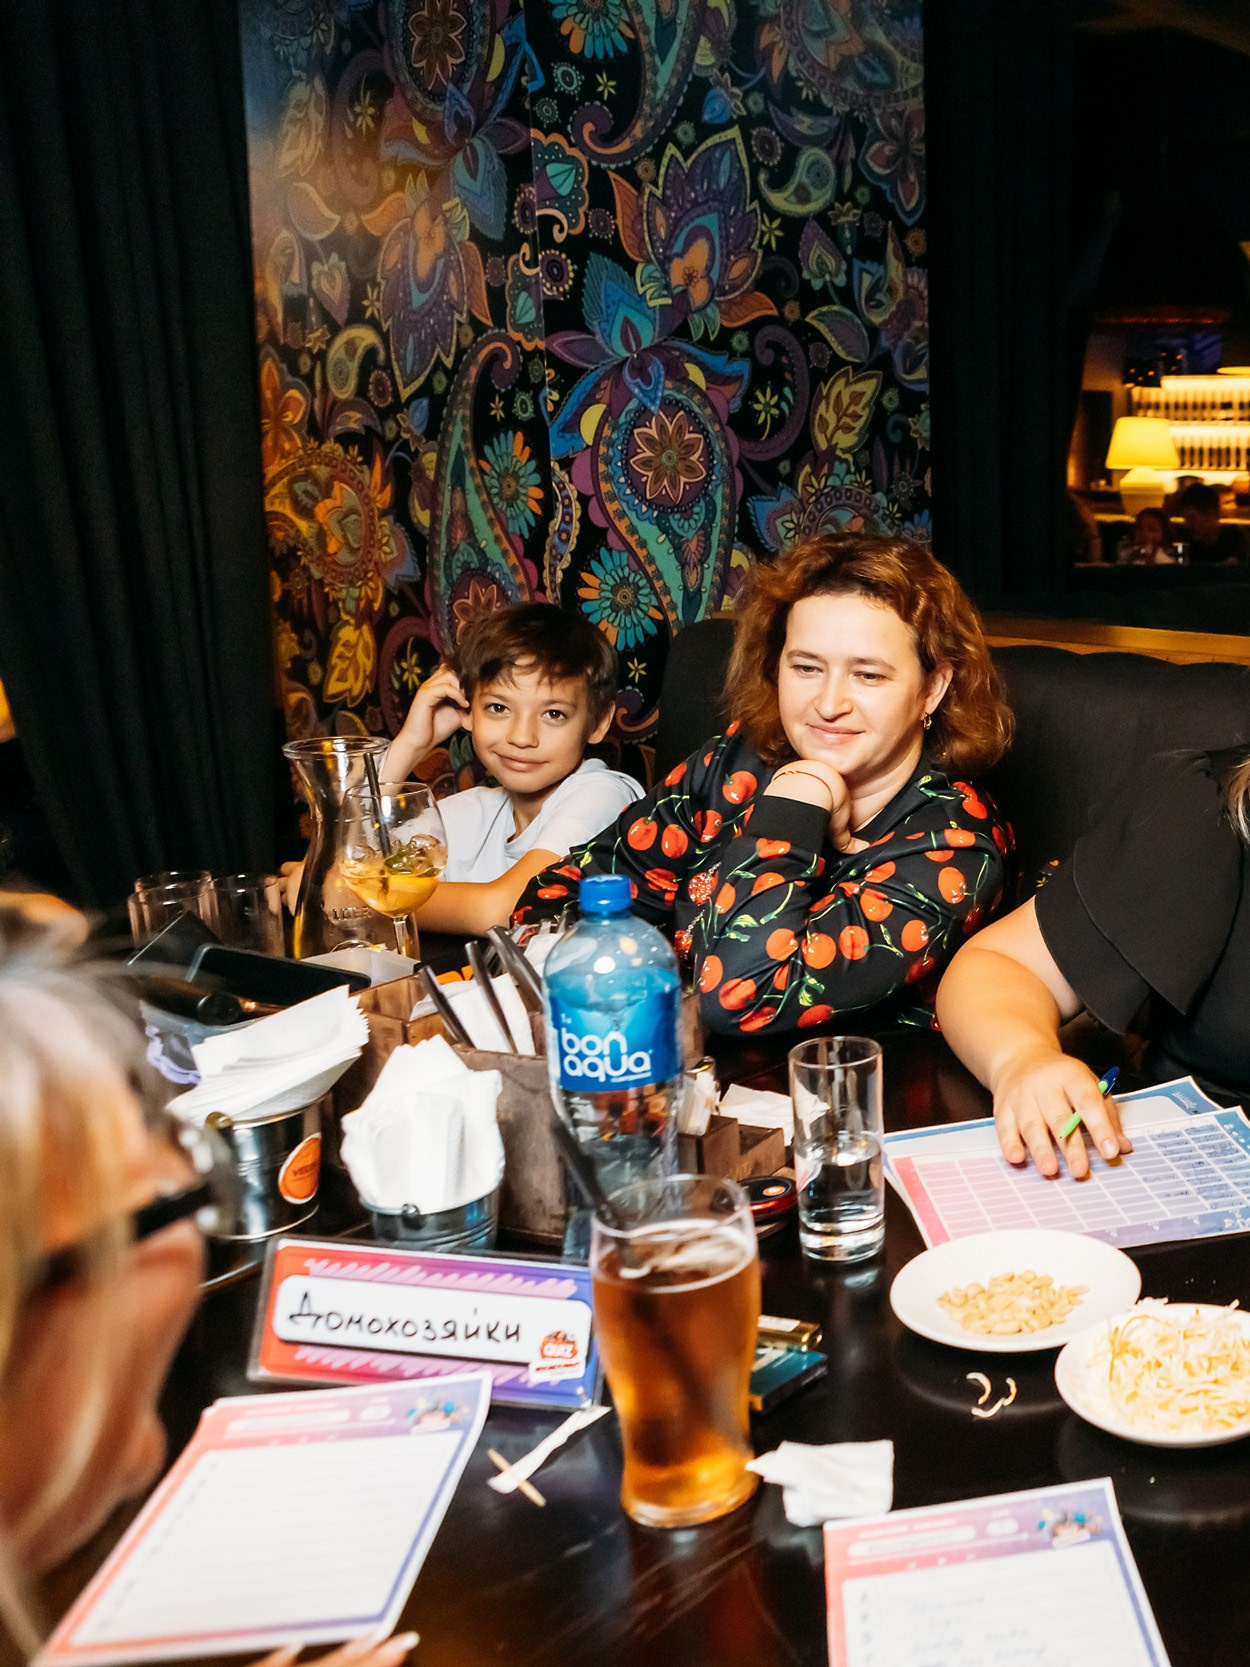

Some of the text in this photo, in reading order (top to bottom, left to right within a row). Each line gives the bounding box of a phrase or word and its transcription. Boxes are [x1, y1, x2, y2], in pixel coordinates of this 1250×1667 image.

[561, 1027, 628, 1057] bon
[563, 1051, 651, 1082] aqua
[287, 1290, 520, 1343] Домохозяйки
